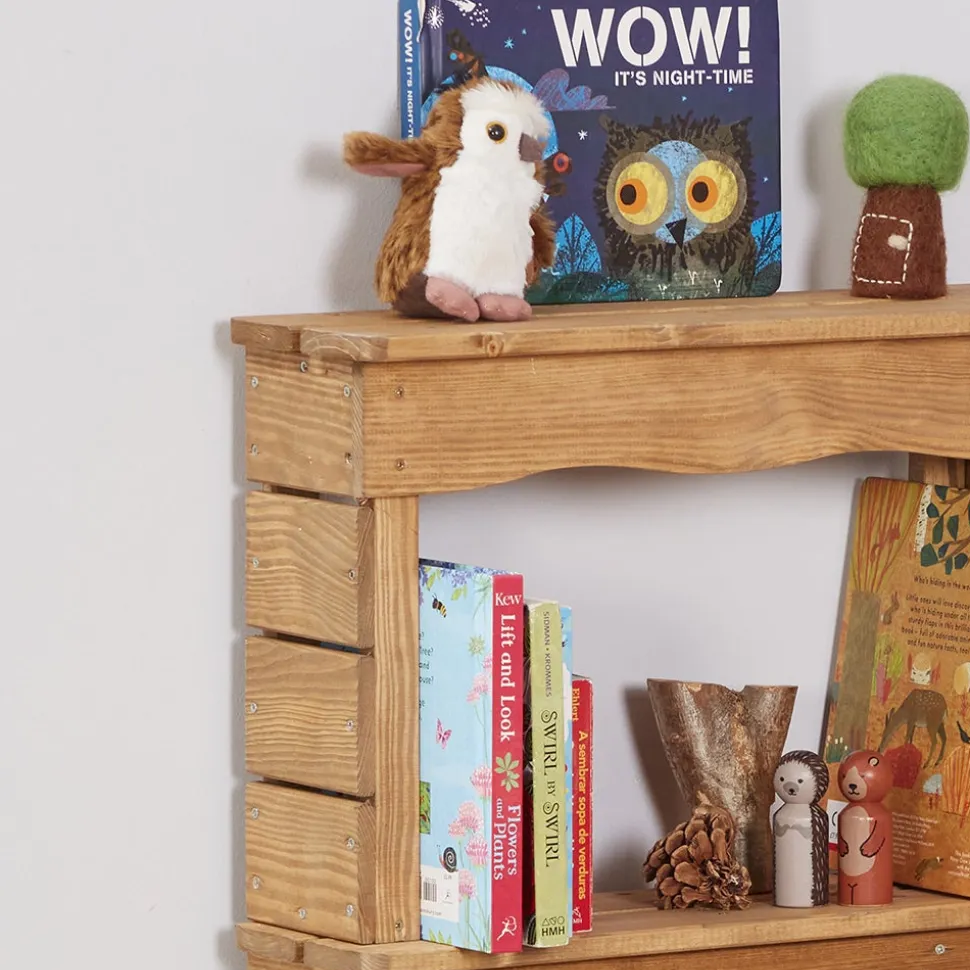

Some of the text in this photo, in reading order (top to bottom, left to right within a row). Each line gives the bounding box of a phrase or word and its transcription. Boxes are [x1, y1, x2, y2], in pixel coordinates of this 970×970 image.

[403, 9, 413, 63] WOW!
[550, 6, 751, 68] WOW!
[614, 69, 754, 87] IT'S NIGHT-TIME
[495, 592, 522, 606] Kew
[930, 577, 946, 589] hiding
[953, 581, 961, 589] the
[542, 611, 550, 646] SIDMAN
[910, 605, 921, 613] who
[927, 607, 943, 619] hiding
[500, 614, 516, 742] Lift and Look
[572, 688, 580, 721] Ehlert
[541, 709, 560, 868] SWIRL BY SWIRL
[578, 731, 588, 900] A sembrar sopa de verduras
[493, 798, 507, 880] and Plants
[507, 804, 521, 876] Flowers
[541, 926, 566, 937] HMH
